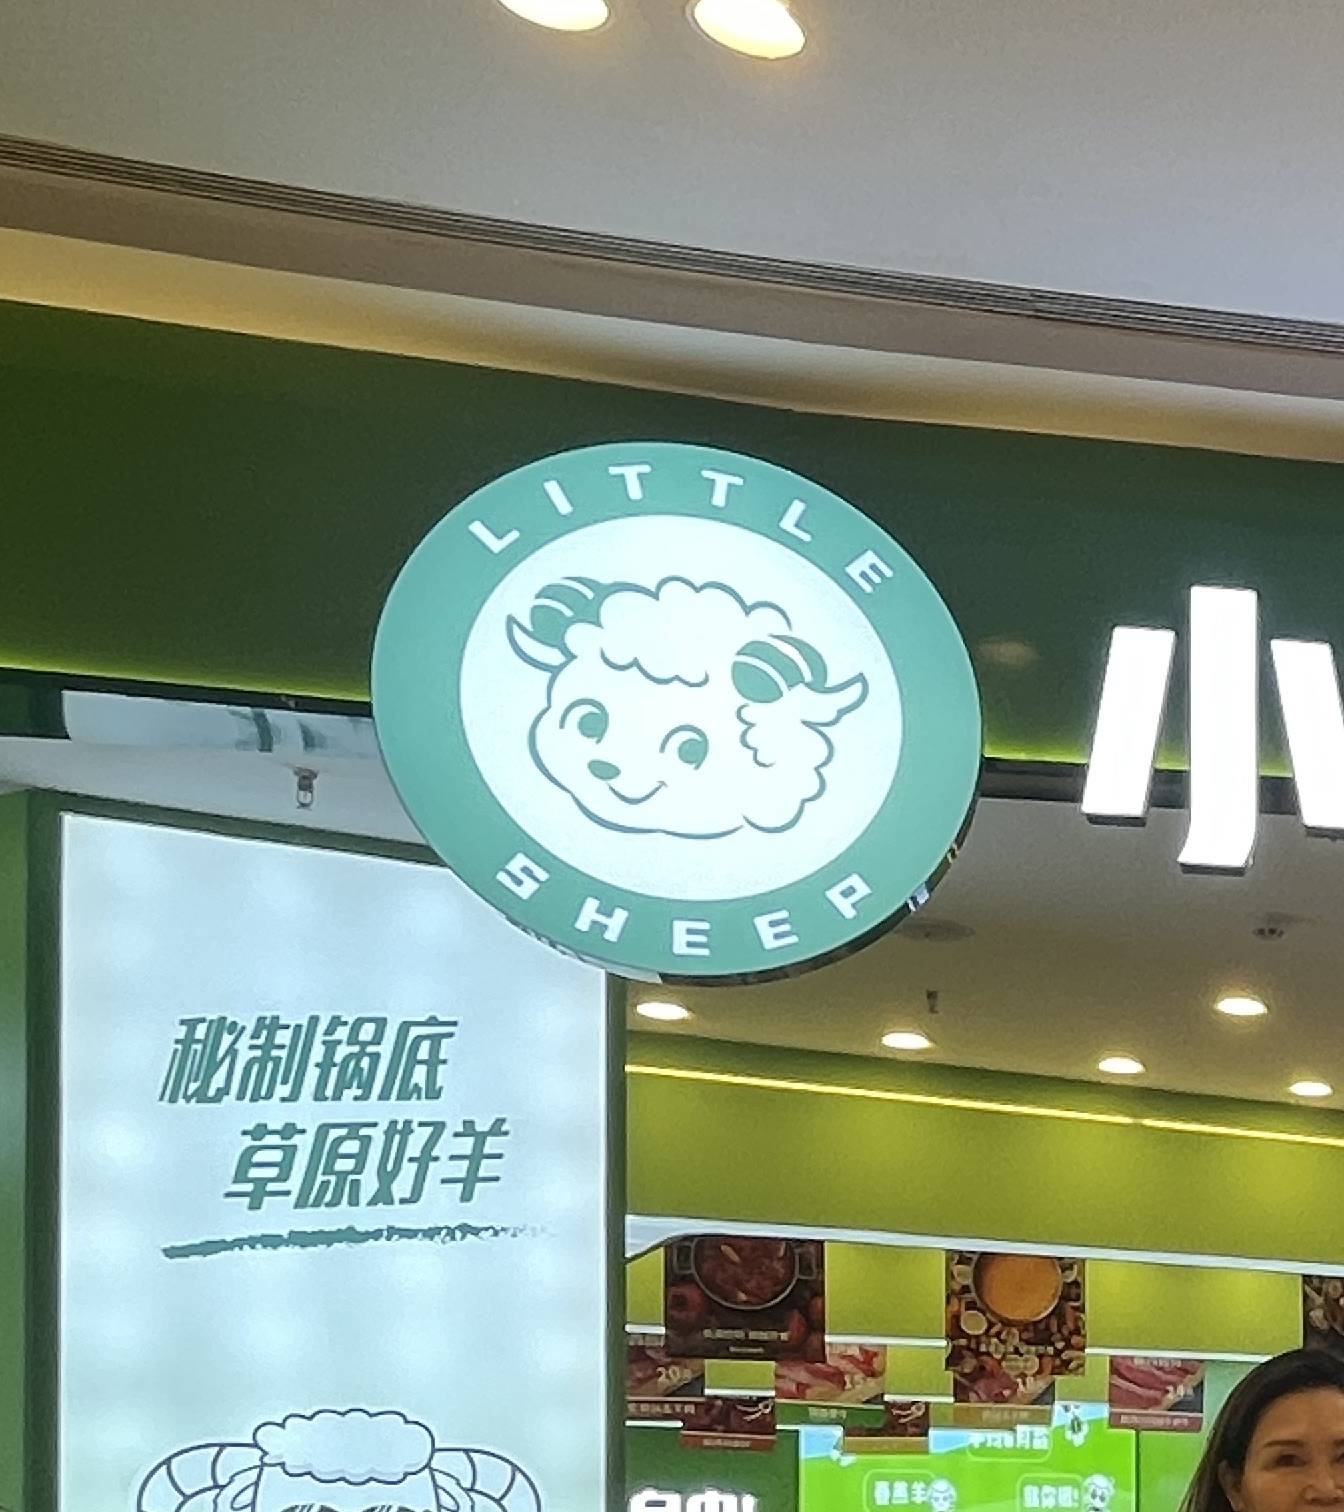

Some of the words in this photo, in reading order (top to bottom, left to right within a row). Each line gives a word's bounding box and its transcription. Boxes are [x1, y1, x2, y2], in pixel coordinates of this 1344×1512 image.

[467, 463, 894, 593] LITTLE
[497, 851, 872, 957] SHEEP
[158, 1015, 458, 1104] 秘制锅底
[224, 1117, 510, 1210] 草原好羊
